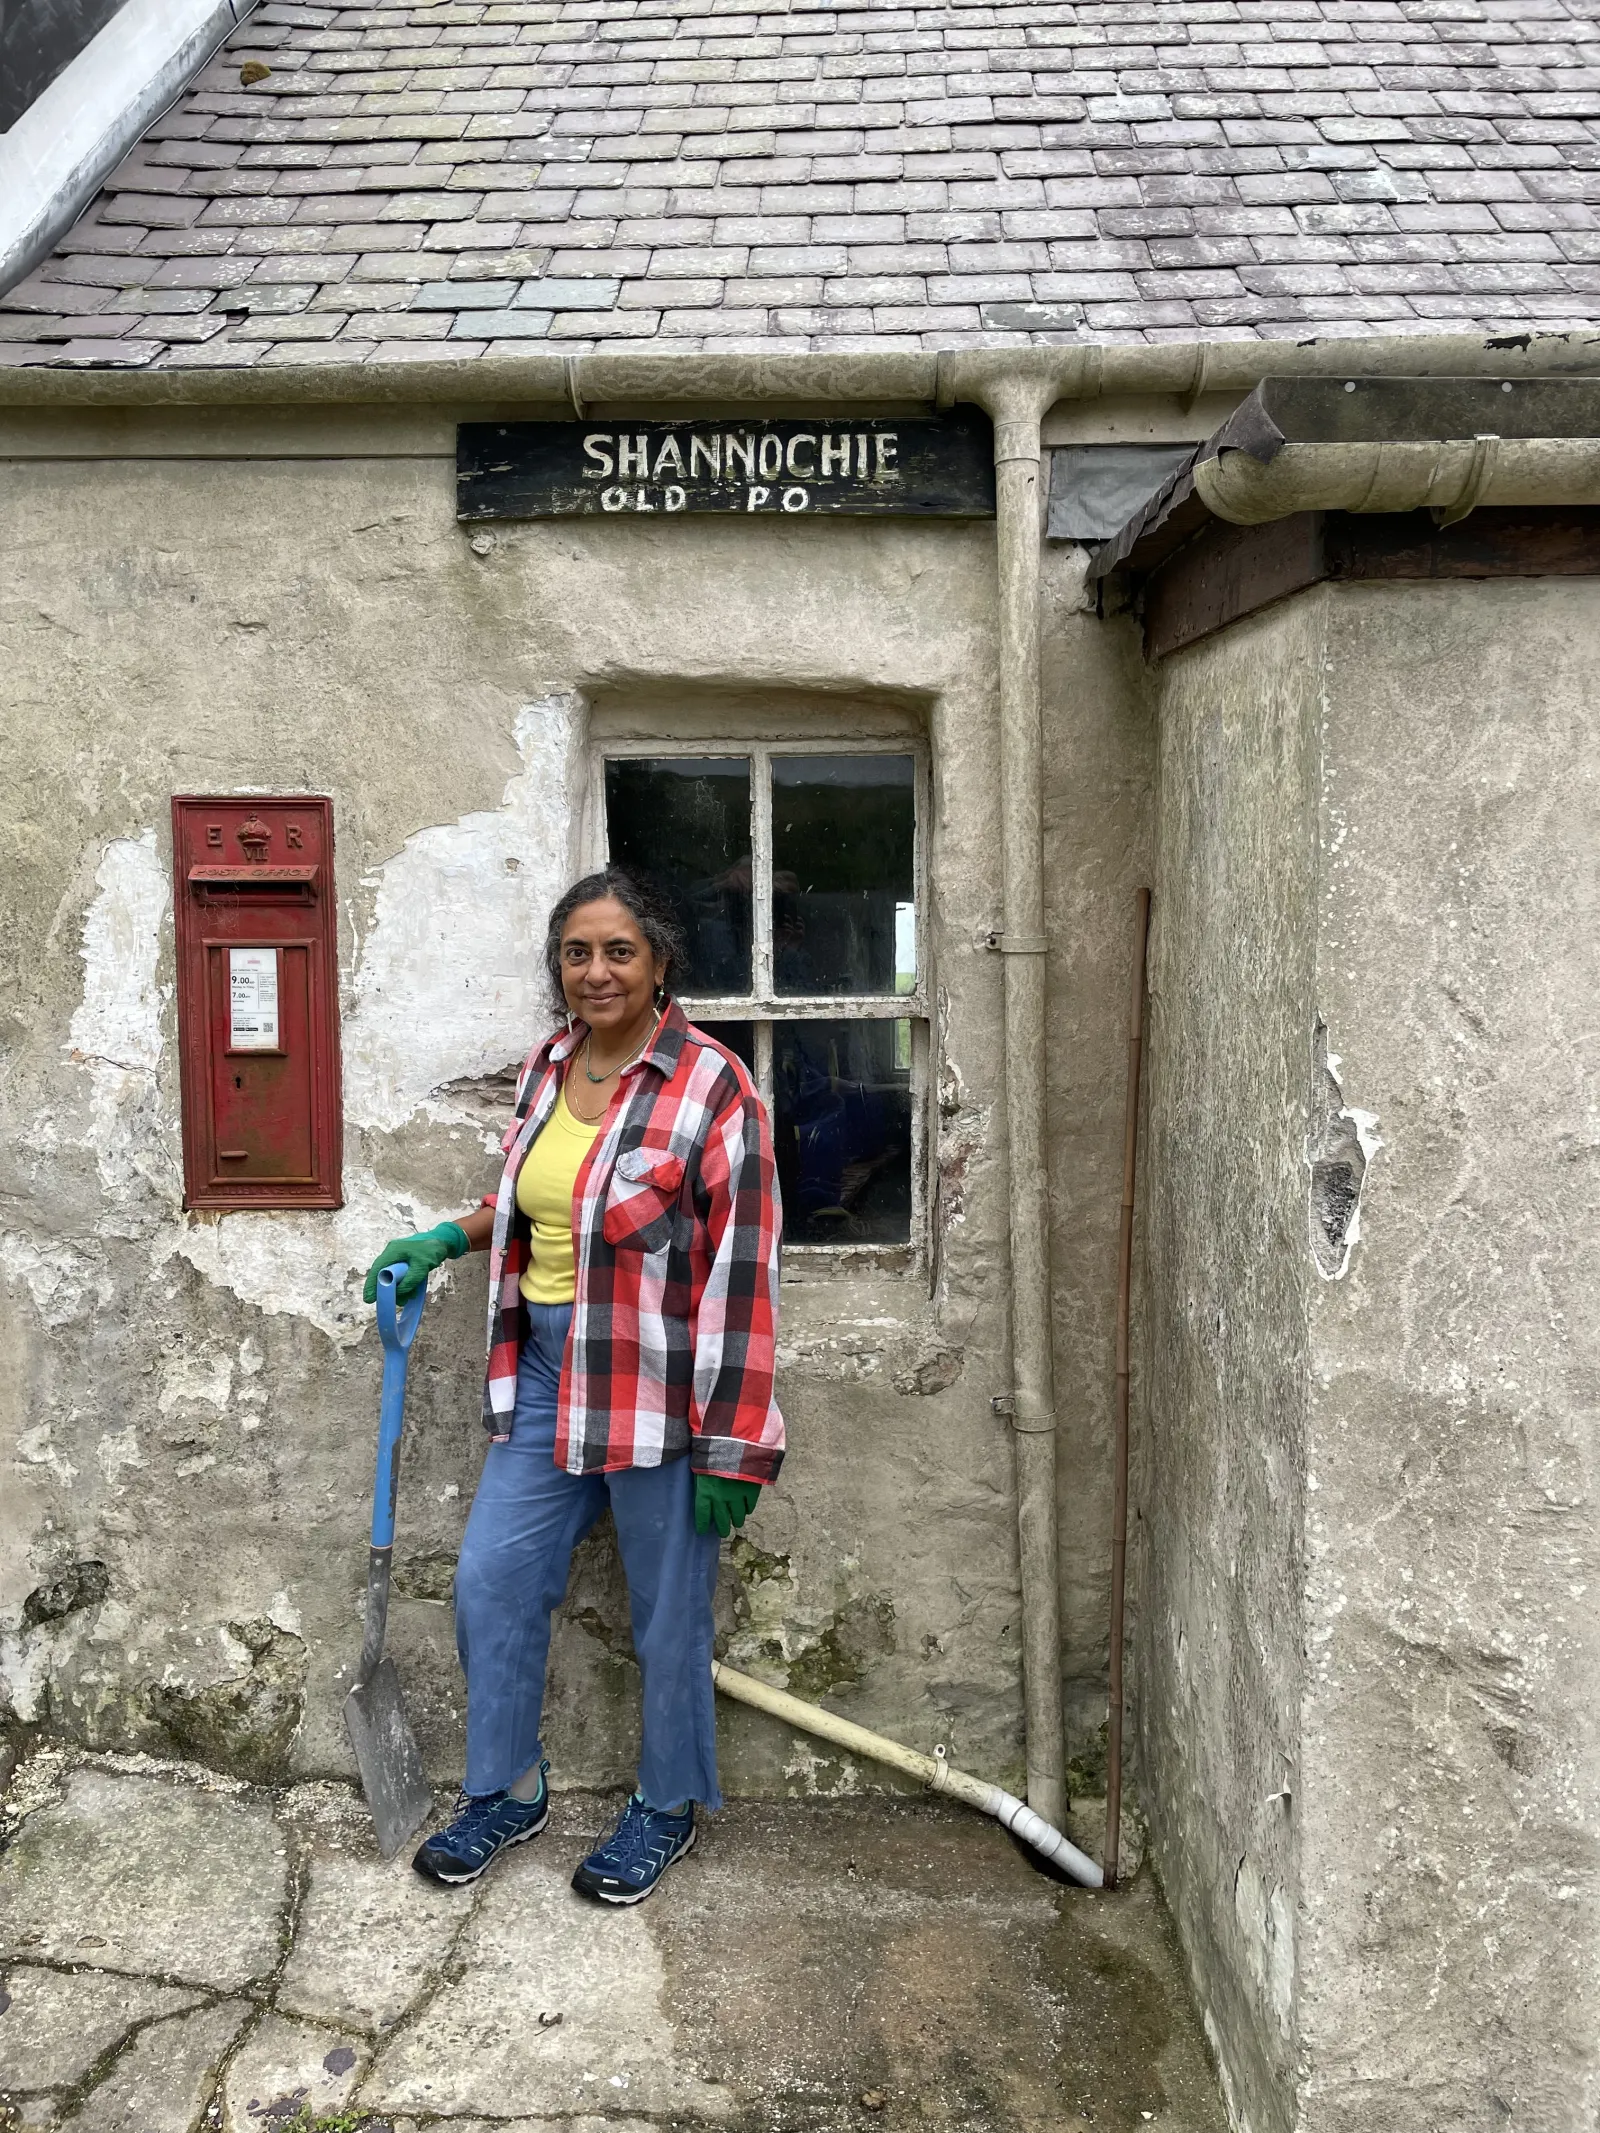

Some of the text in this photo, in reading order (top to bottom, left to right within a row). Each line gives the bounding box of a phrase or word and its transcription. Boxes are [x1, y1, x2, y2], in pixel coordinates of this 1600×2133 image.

[581, 432, 900, 478] SHANNOCHIE
[601, 485, 686, 512] OLD
[206, 825, 303, 848] E R
[243, 846, 269, 861] VII
[195, 867, 312, 876] POST OFFICE
